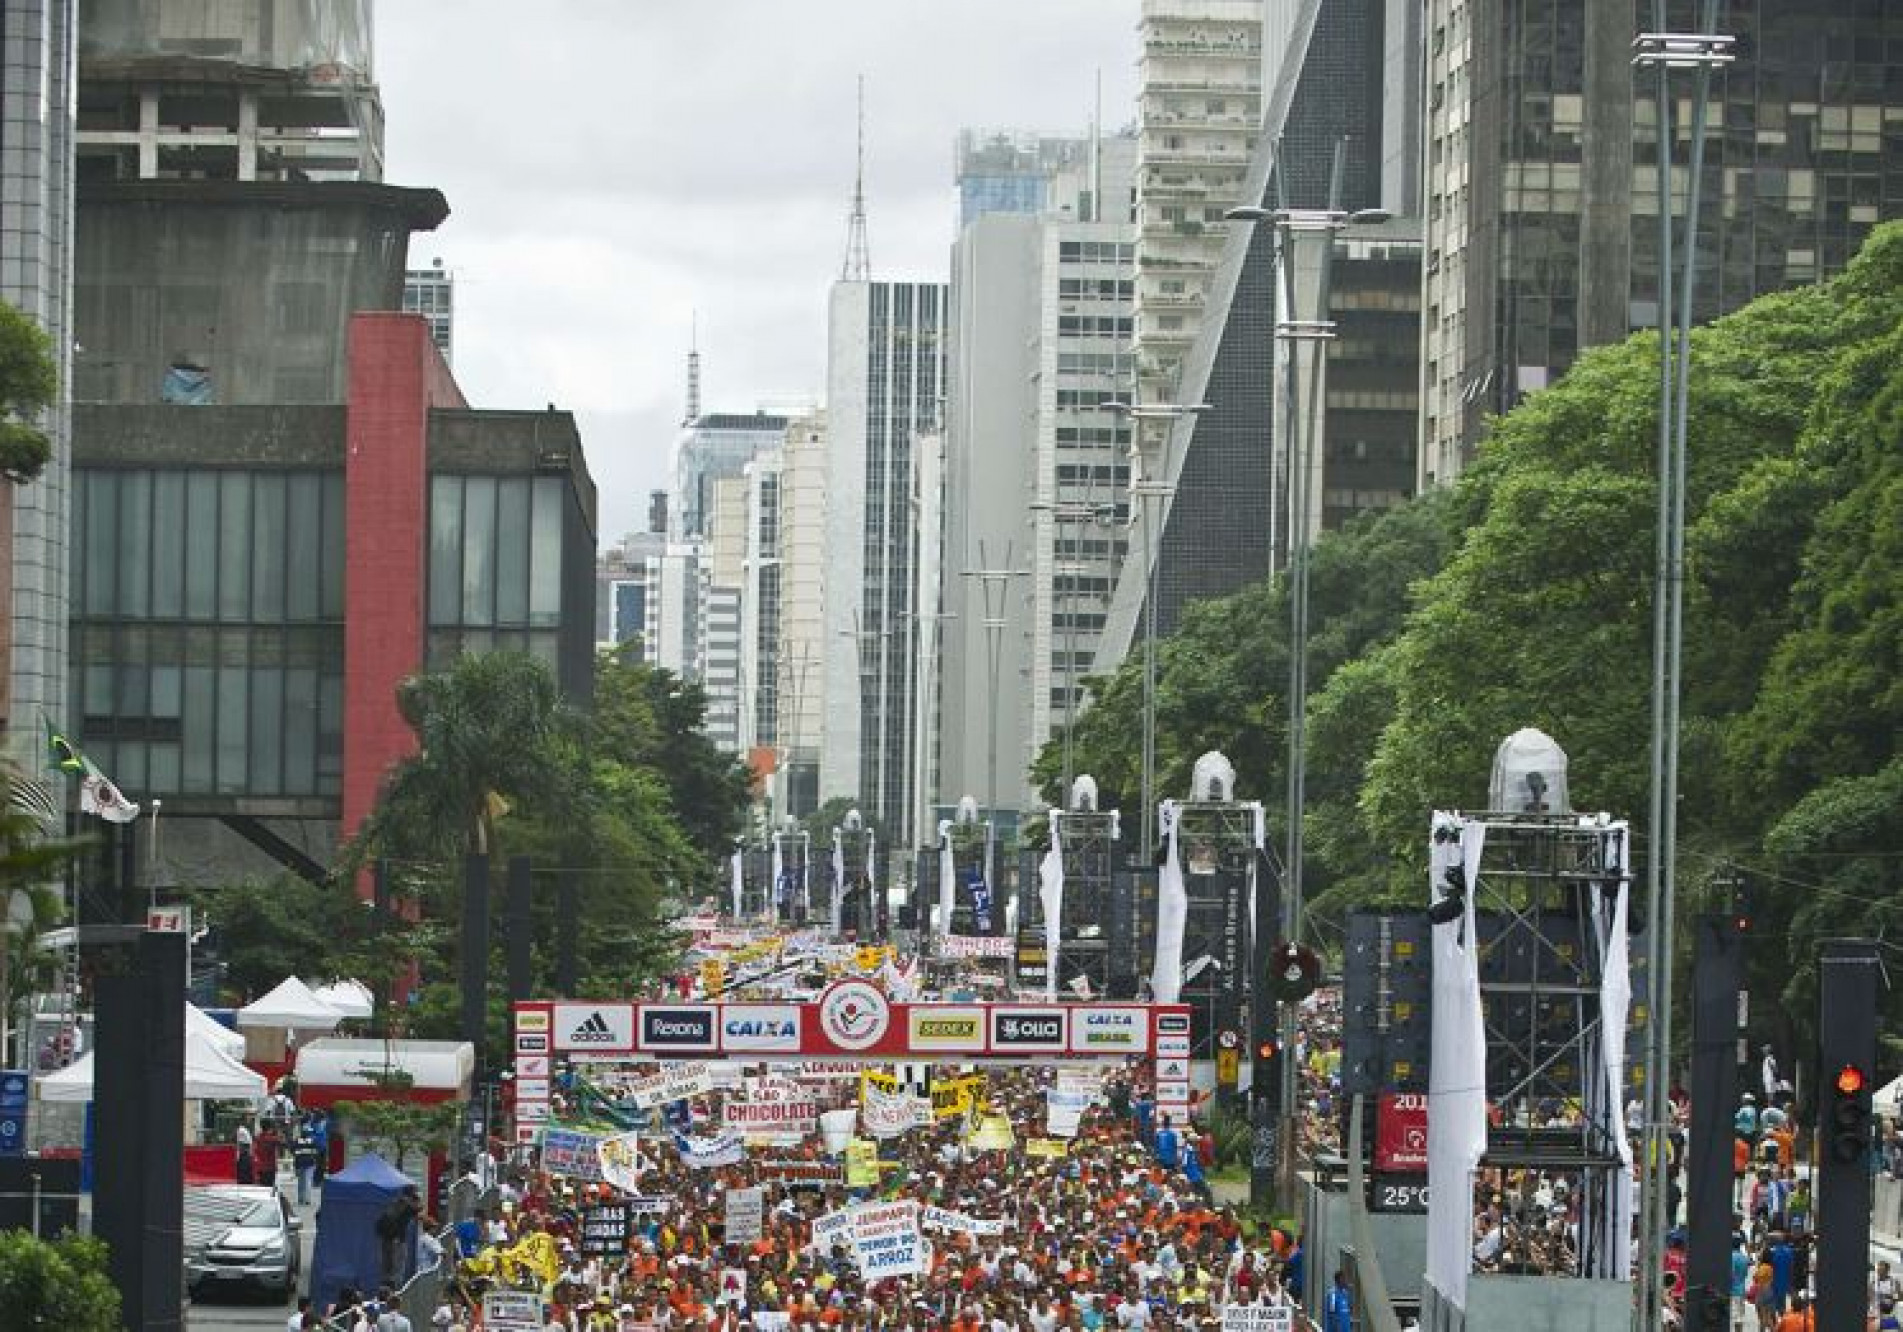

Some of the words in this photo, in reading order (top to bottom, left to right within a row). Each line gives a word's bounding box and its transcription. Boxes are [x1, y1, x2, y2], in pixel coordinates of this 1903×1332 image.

[652, 1017, 704, 1037] Rexona
[725, 1020, 796, 1037] CAIXA
[1087, 1015, 1132, 1025] CAIXA
[571, 1031, 617, 1042] adidas
[1393, 1093, 1428, 1110] 201
[728, 1102, 816, 1122] CHOCOLATE
[868, 1247, 915, 1267] ARROZ
